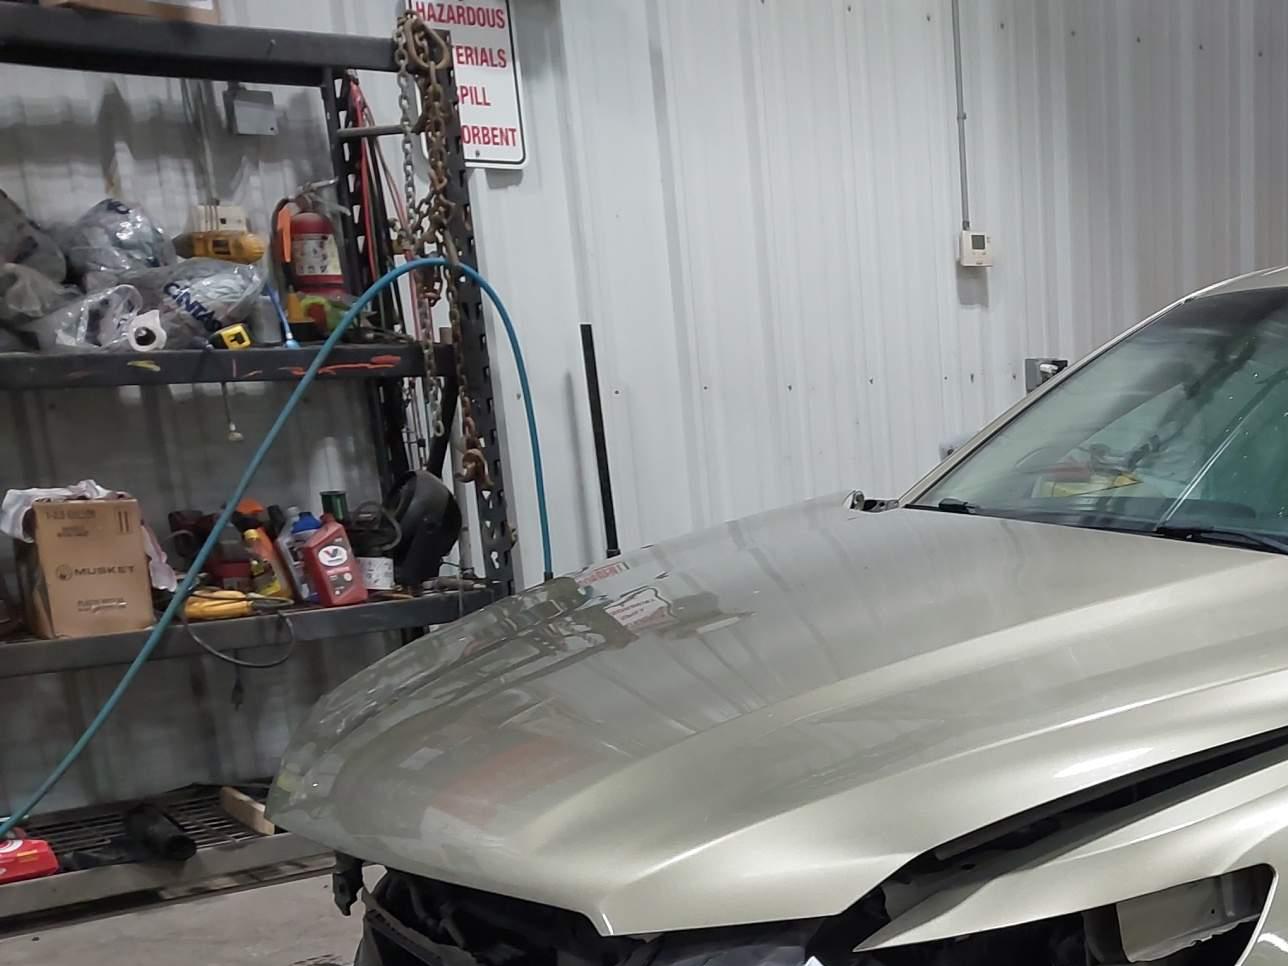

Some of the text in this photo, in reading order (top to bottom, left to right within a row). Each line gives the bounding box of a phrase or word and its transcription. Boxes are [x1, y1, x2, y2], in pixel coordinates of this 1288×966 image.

[415, 1, 505, 29] HAZARDOUS
[454, 45, 507, 68] ERIALS
[457, 85, 491, 107] PILL
[460, 124, 516, 147] ORBENT
[74, 565, 135, 577] MUSKET
